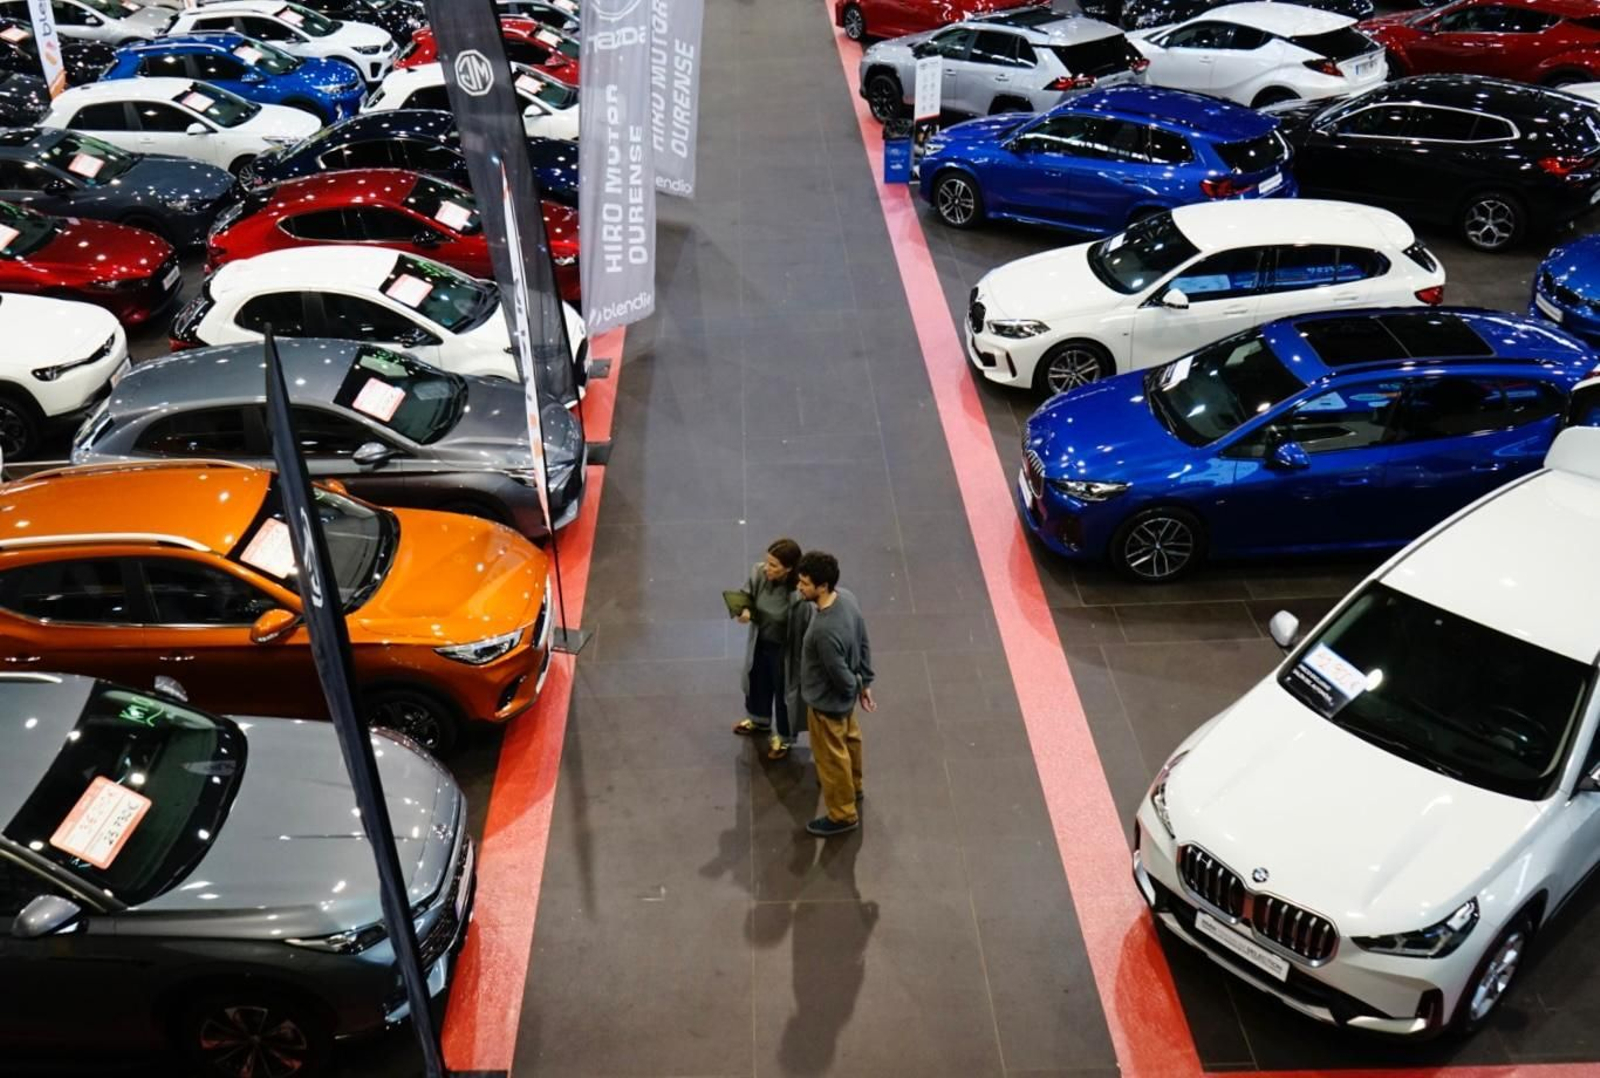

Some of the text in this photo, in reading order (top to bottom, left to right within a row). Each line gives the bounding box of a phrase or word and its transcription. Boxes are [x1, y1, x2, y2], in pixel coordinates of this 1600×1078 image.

[670, 38, 695, 159] OURENSE
[602, 203, 623, 273] HIRO
[628, 125, 649, 265] OURENSE
